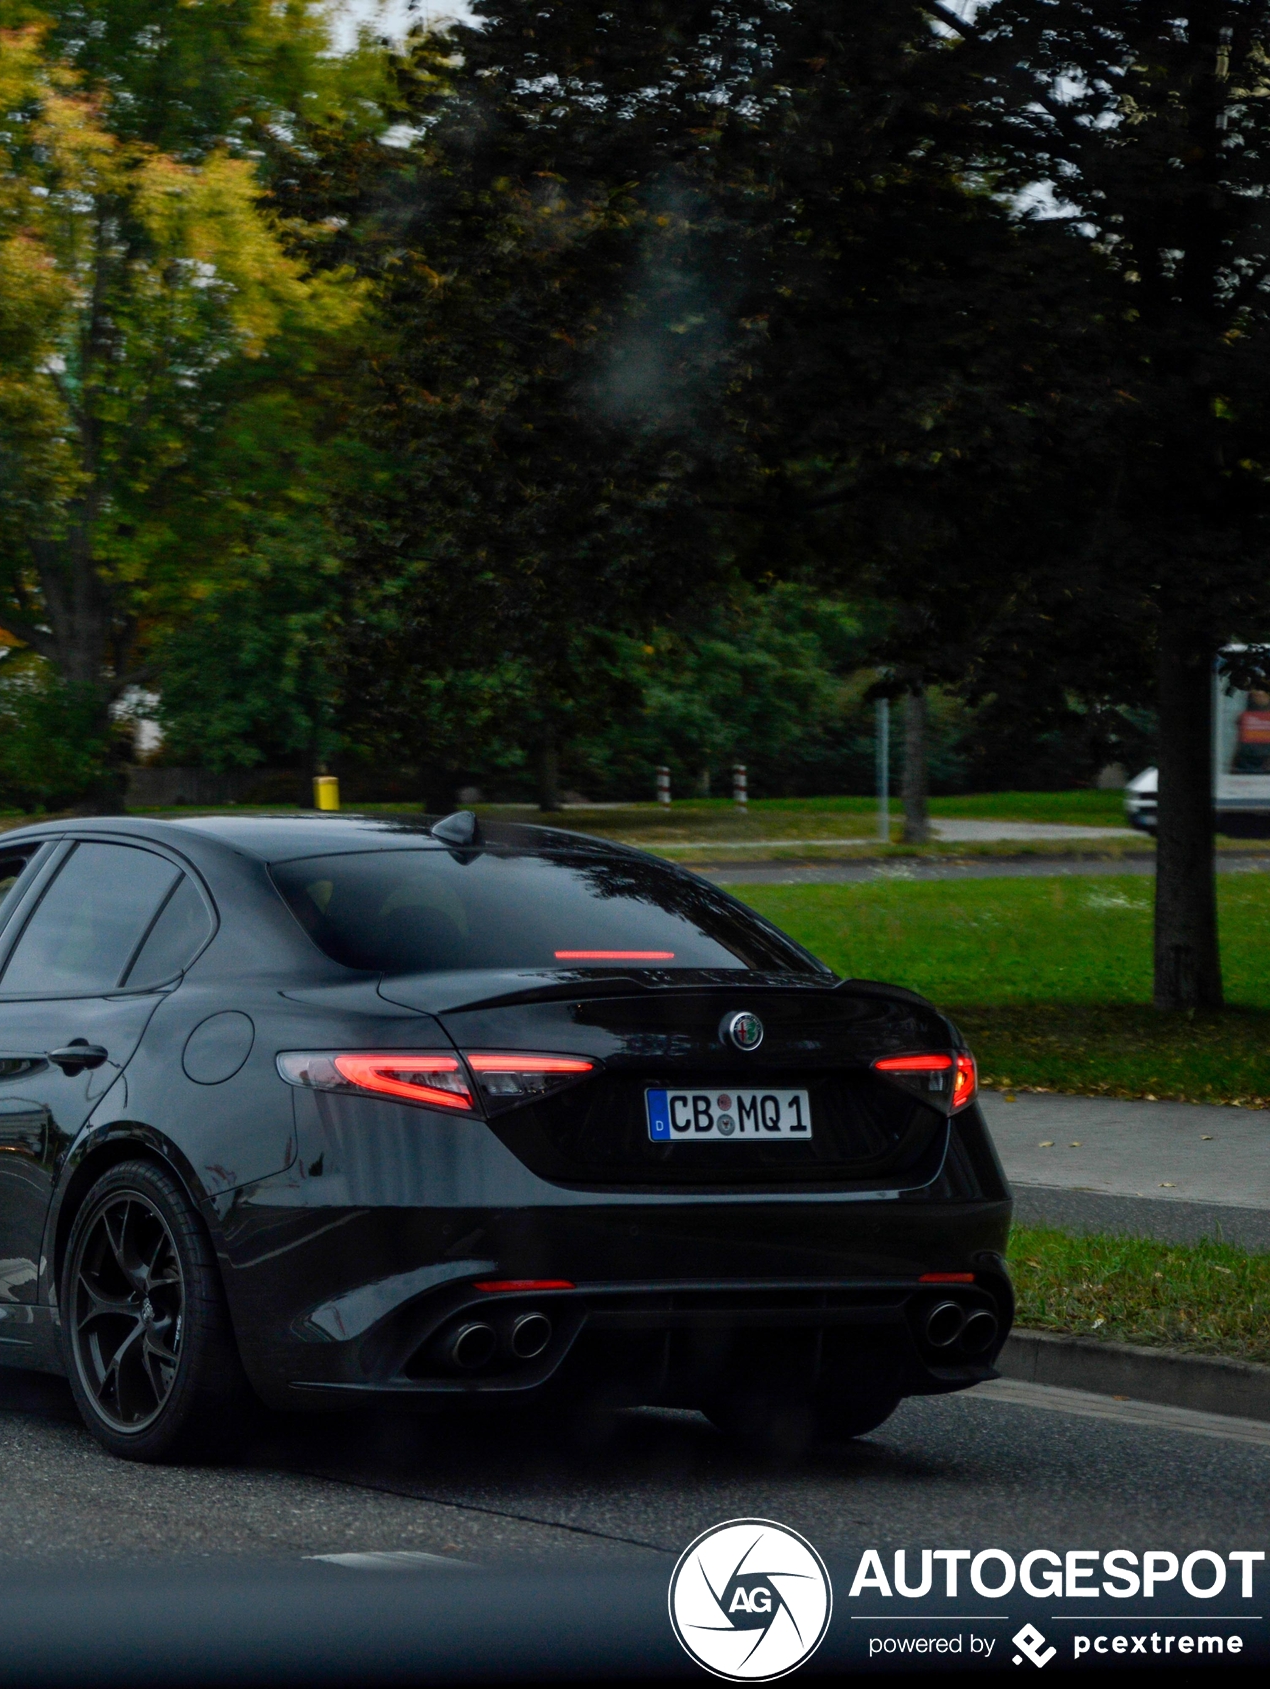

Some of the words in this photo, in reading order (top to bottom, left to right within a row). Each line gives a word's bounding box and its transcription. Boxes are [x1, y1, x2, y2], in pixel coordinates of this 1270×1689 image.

[656, 1120, 664, 1131] D
[669, 1095, 714, 1132] CB
[736, 1095, 782, 1132] MQ
[788, 1095, 807, 1131] 1
